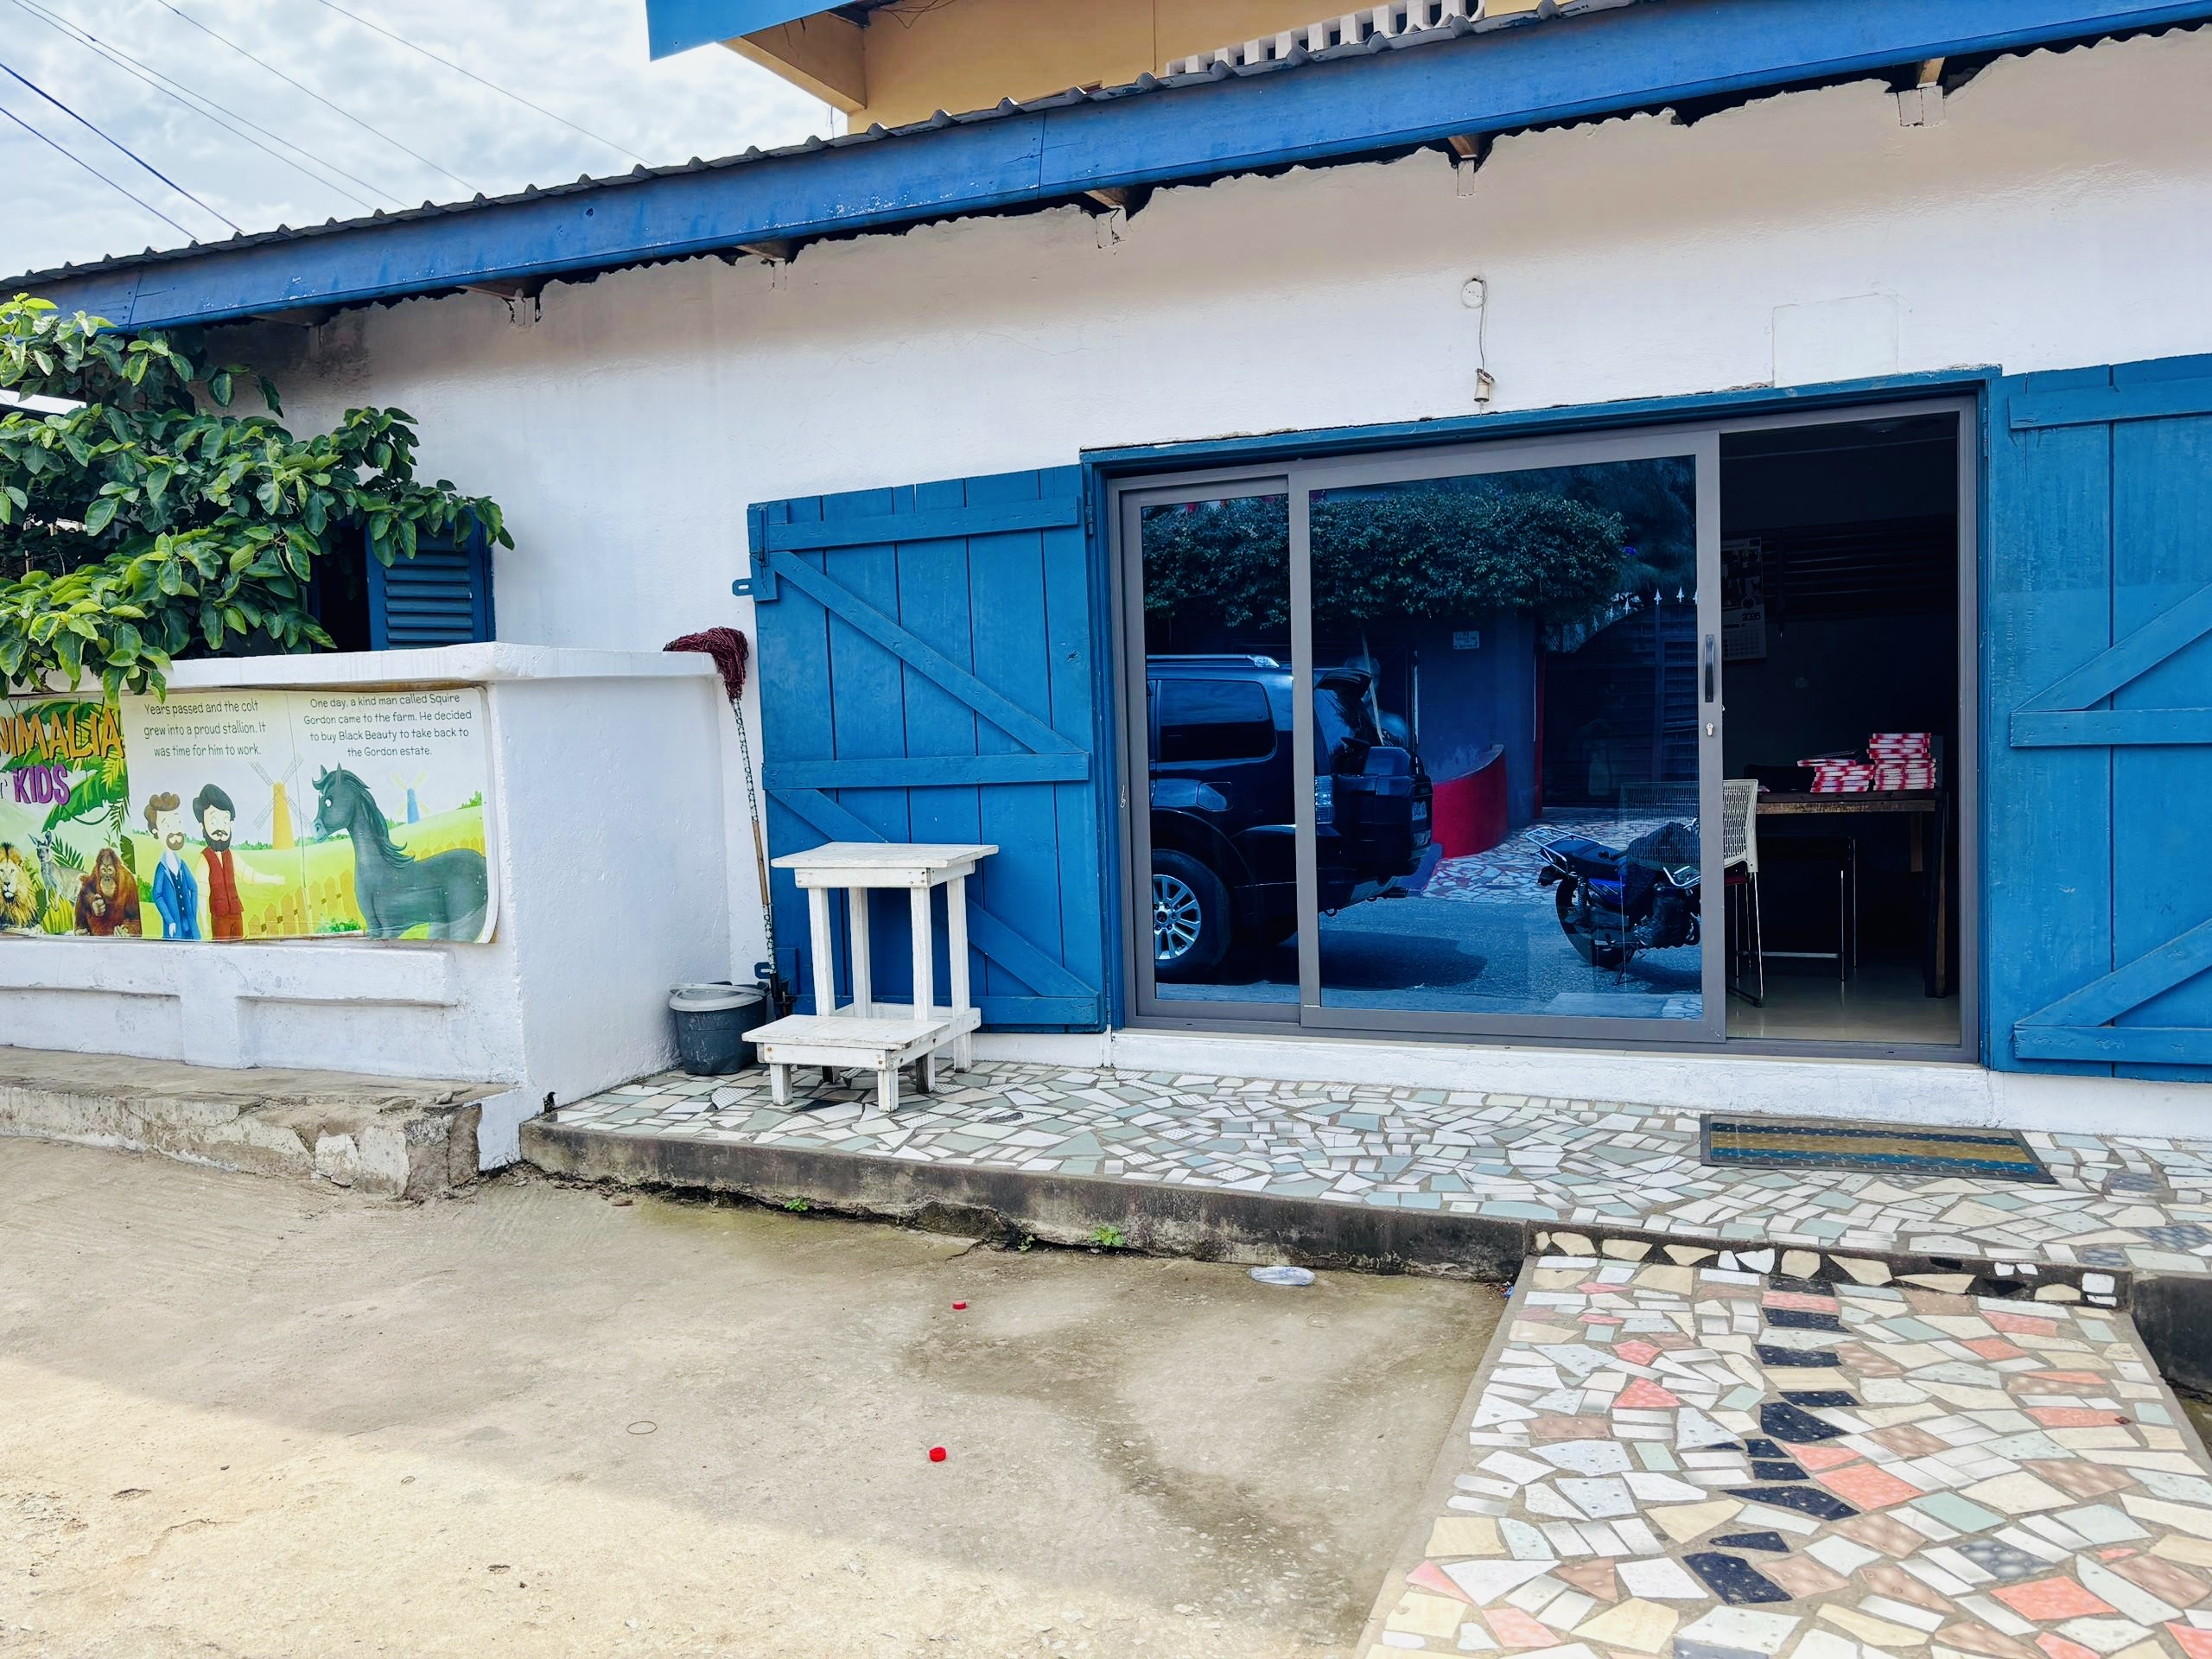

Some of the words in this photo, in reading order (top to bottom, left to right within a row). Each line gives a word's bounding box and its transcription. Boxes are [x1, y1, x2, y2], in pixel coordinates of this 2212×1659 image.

[144, 703, 170, 715] Years
[173, 702, 203, 716] passed
[207, 702, 221, 713] and
[225, 700, 238, 712] the
[242, 698, 258, 711] colt
[310, 699, 327, 708] One
[330, 697, 348, 709] day,
[358, 696, 376, 706] kind
[400, 693, 427, 704] called
[429, 693, 460, 705] Squire
[304, 715, 336, 725] Gordon
[364, 714, 372, 722] to
[375, 713, 390, 722] the
[392, 712, 417, 721] farm.
[420, 712, 432, 721] He
[435, 710, 472, 720] decided
[144, 726, 165, 739] grew
[168, 724, 184, 734] into
[194, 724, 220, 738] proud
[223, 720, 257, 734] stallion.
[259, 721, 266, 732] It
[309, 733, 319, 741] to
[321, 733, 336, 743] buy
[339, 730, 363, 741] Black
[365, 730, 397, 741] Beauty
[400, 730, 409, 739] to
[411, 728, 431, 738] take
[434, 728, 456, 737] back
[459, 728, 468, 736] to
[154, 747, 170, 756] was
[173, 746, 190, 756] time
[193, 744, 206, 755] for
[208, 744, 223, 755] him
[226, 744, 235, 755] to
[238, 743, 261, 754] work.
[347, 747, 362, 757] the
[365, 747, 397, 756] Gordon
[400, 746, 432, 755] estate.
[13, 764, 70, 806] KIDS
